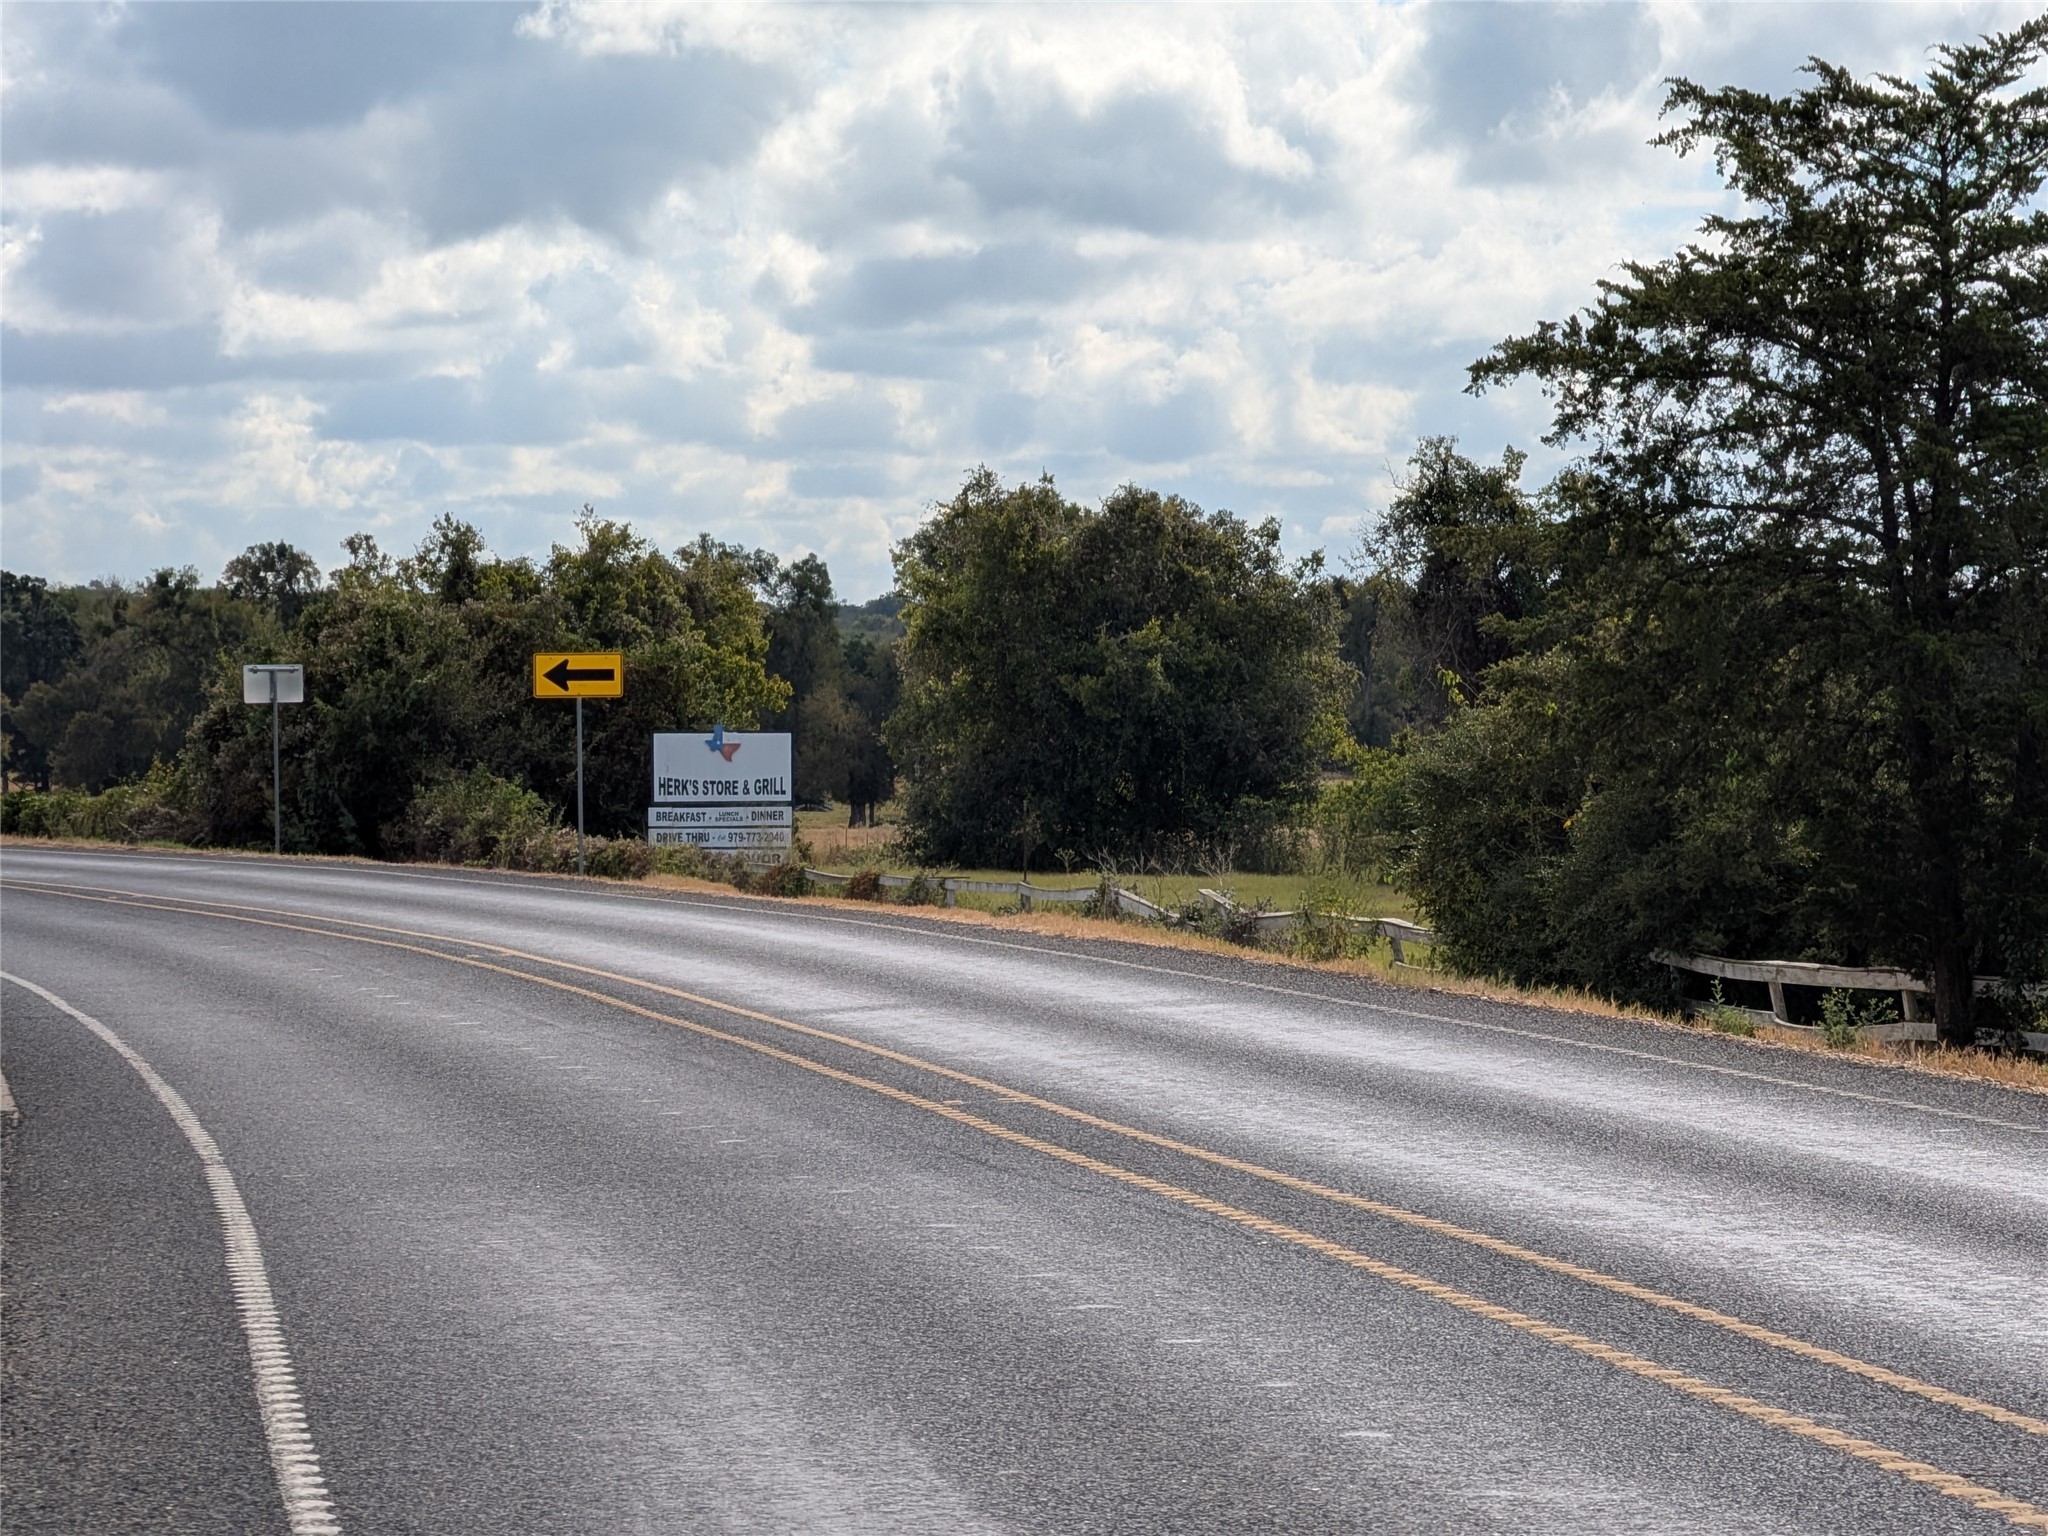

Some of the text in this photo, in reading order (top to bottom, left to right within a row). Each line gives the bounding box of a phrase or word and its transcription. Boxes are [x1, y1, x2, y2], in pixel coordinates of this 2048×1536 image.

[658, 776, 787, 796] HERK'S STORE & GRILL
[655, 810, 784, 822] BREAKFAST DINNER
[656, 832, 684, 843] DRIVE
[686, 832, 710, 843] THRU
